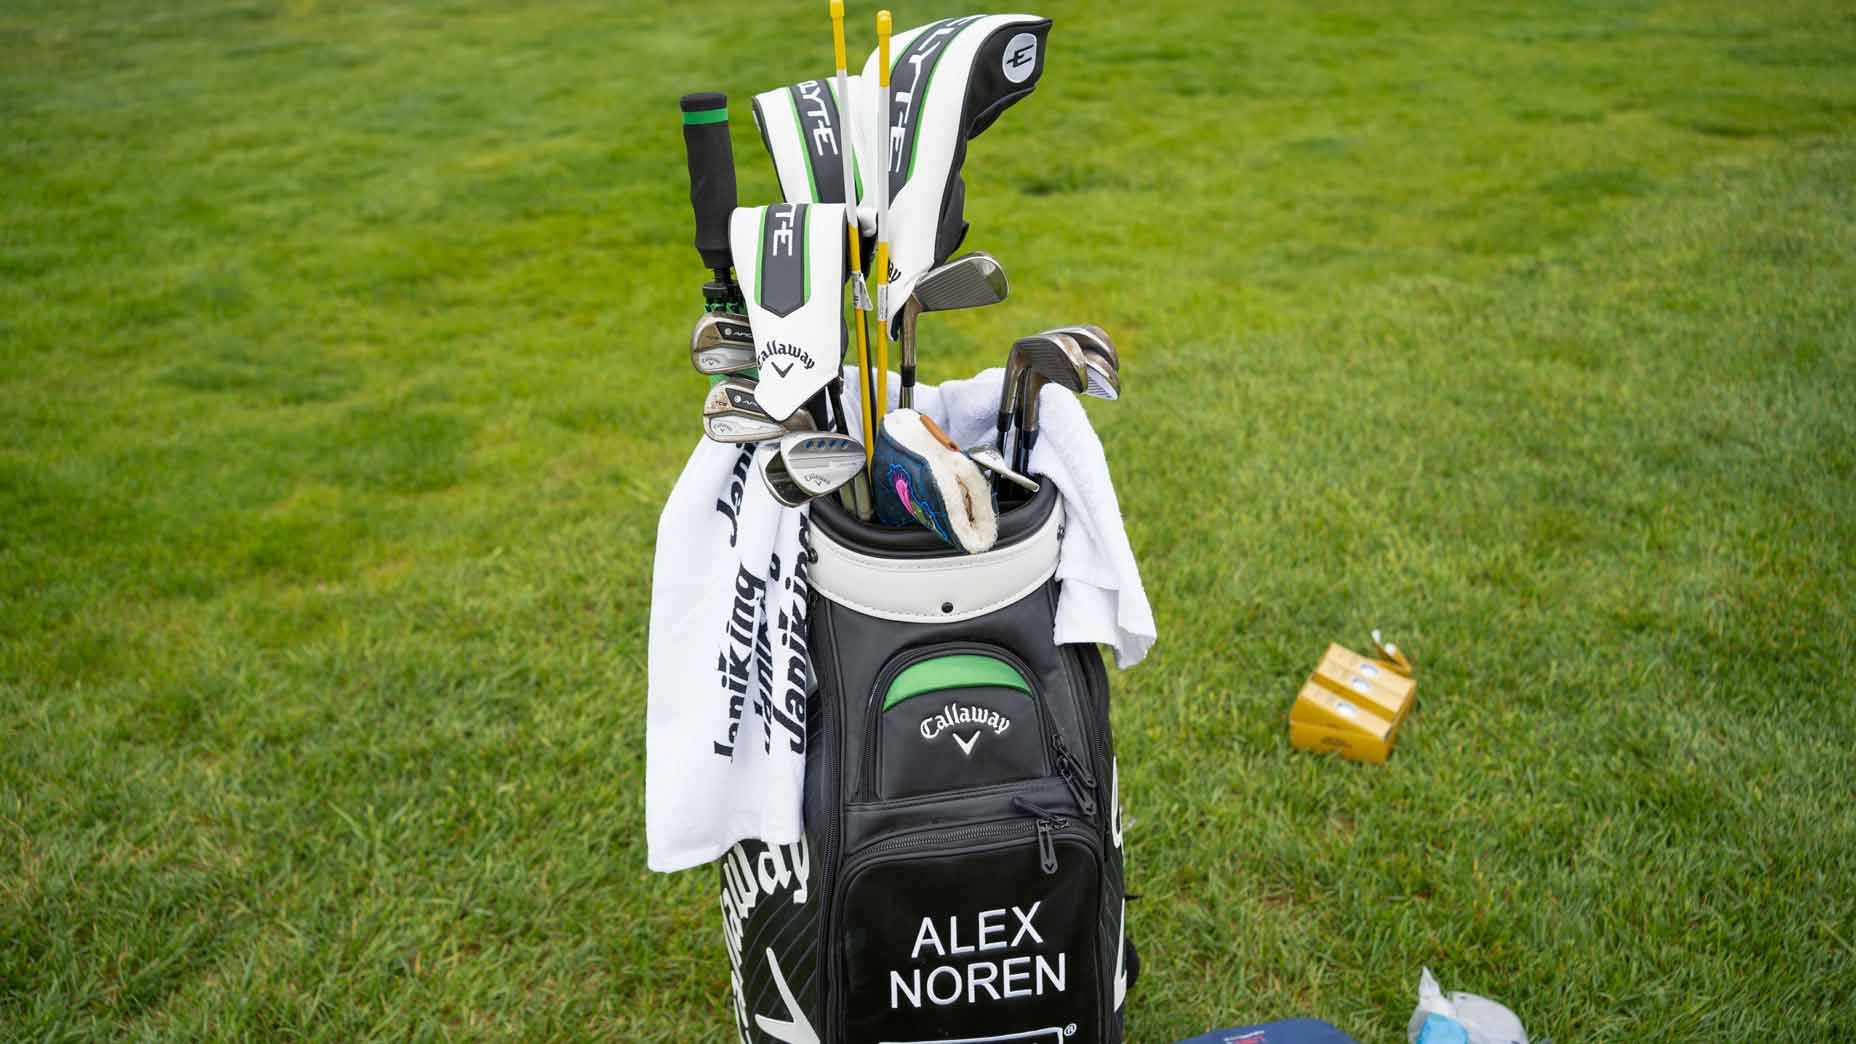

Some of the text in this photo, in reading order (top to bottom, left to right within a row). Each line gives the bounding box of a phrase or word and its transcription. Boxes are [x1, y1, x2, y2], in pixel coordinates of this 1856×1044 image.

[920, 703, 1010, 739] Callaway
[911, 901, 1044, 959] ALEX
[889, 952, 1066, 1009] NOREN
